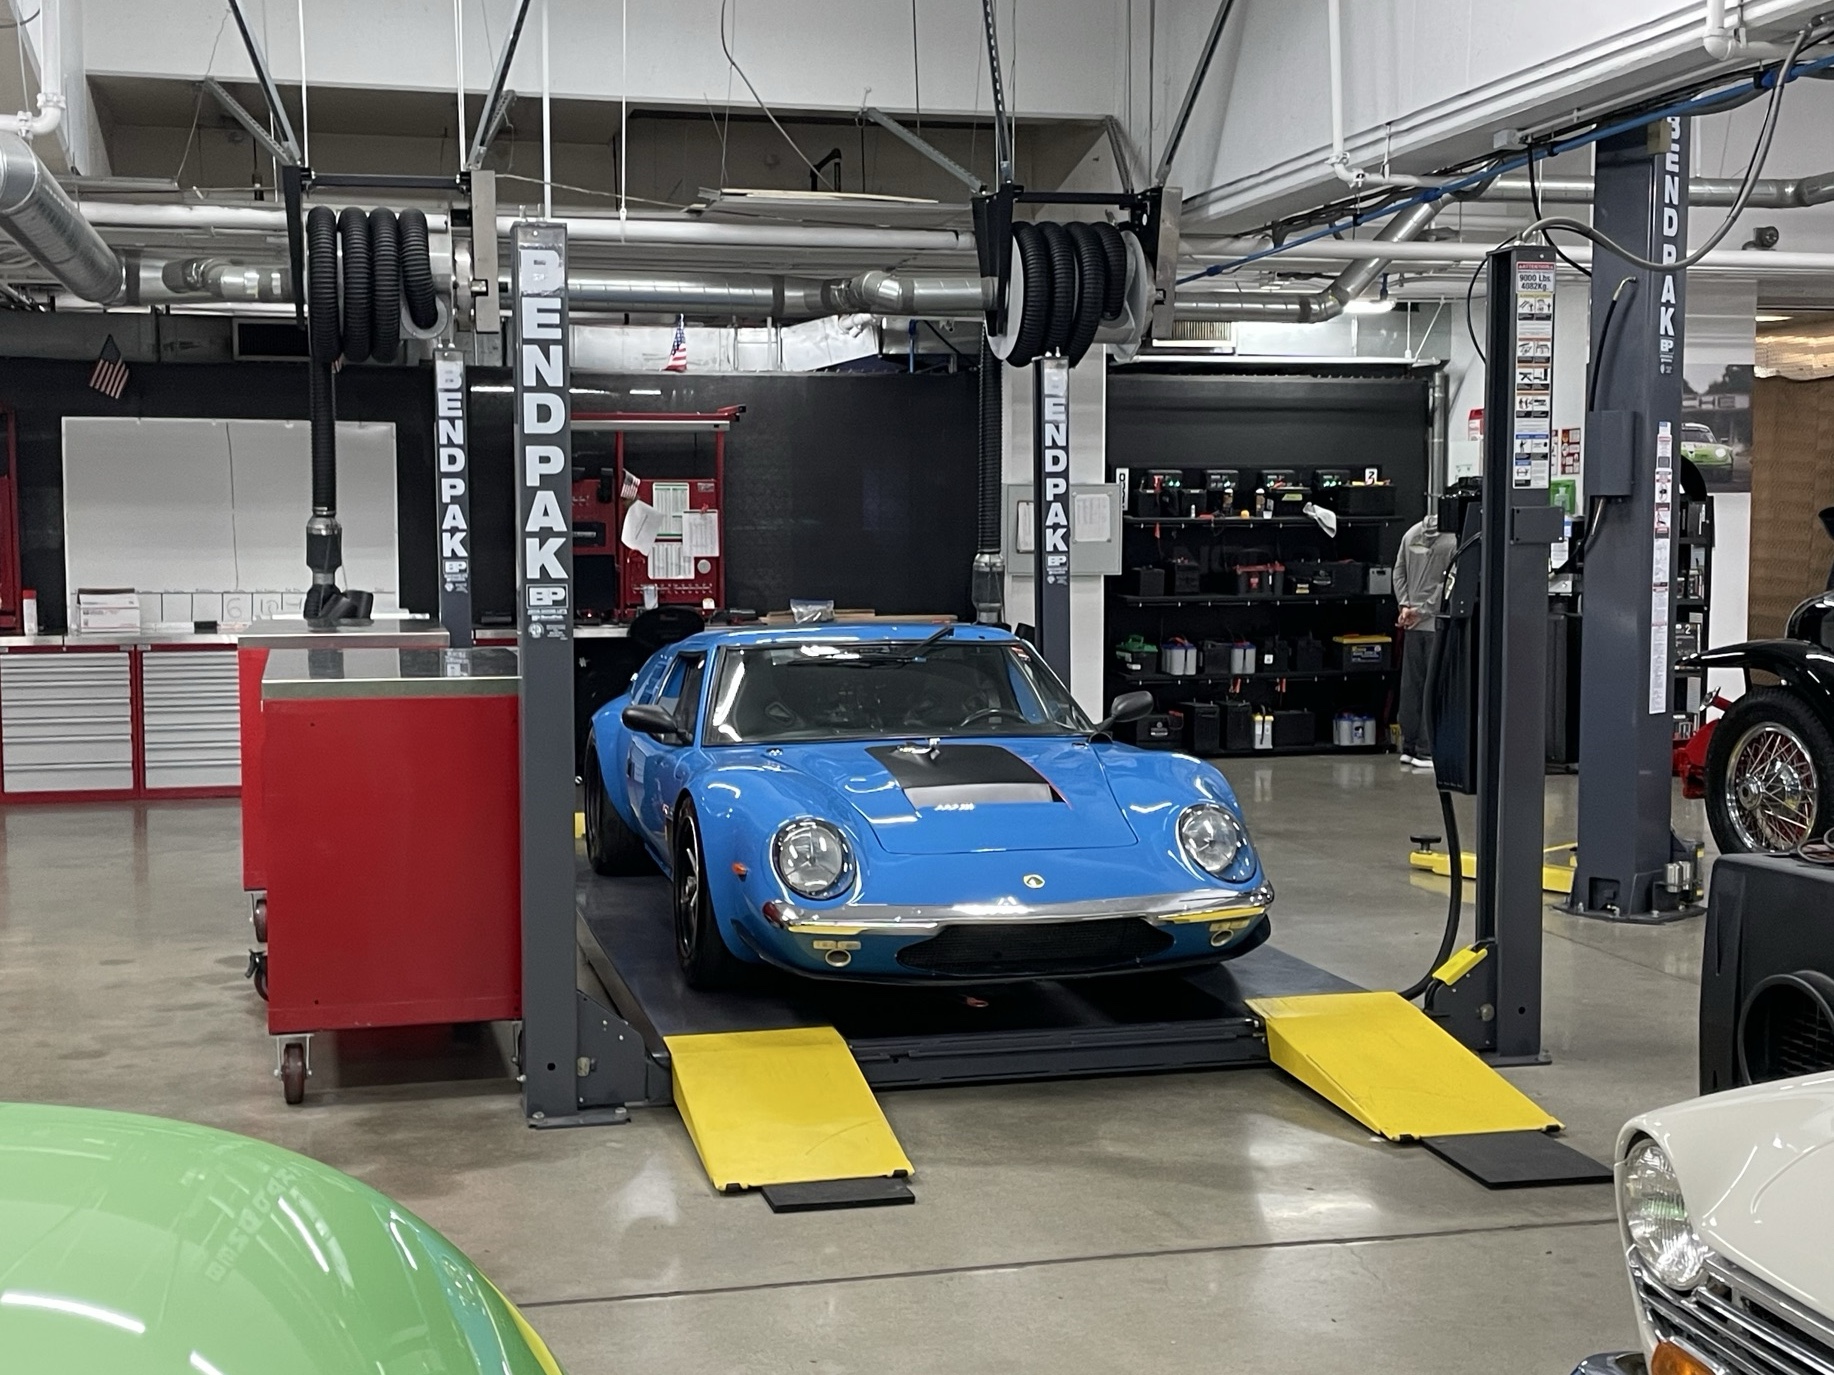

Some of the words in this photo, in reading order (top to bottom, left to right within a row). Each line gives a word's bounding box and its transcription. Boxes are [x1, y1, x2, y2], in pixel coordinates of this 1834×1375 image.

[1519, 274, 1537, 282] 9000
[520, 249, 569, 579] BENDPAK
[437, 361, 469, 557] BENDPAK
[1044, 368, 1069, 552] BENDPAK
[445, 561, 467, 573] BP
[1047, 555, 1067, 566] BP
[529, 587, 566, 606] BP
